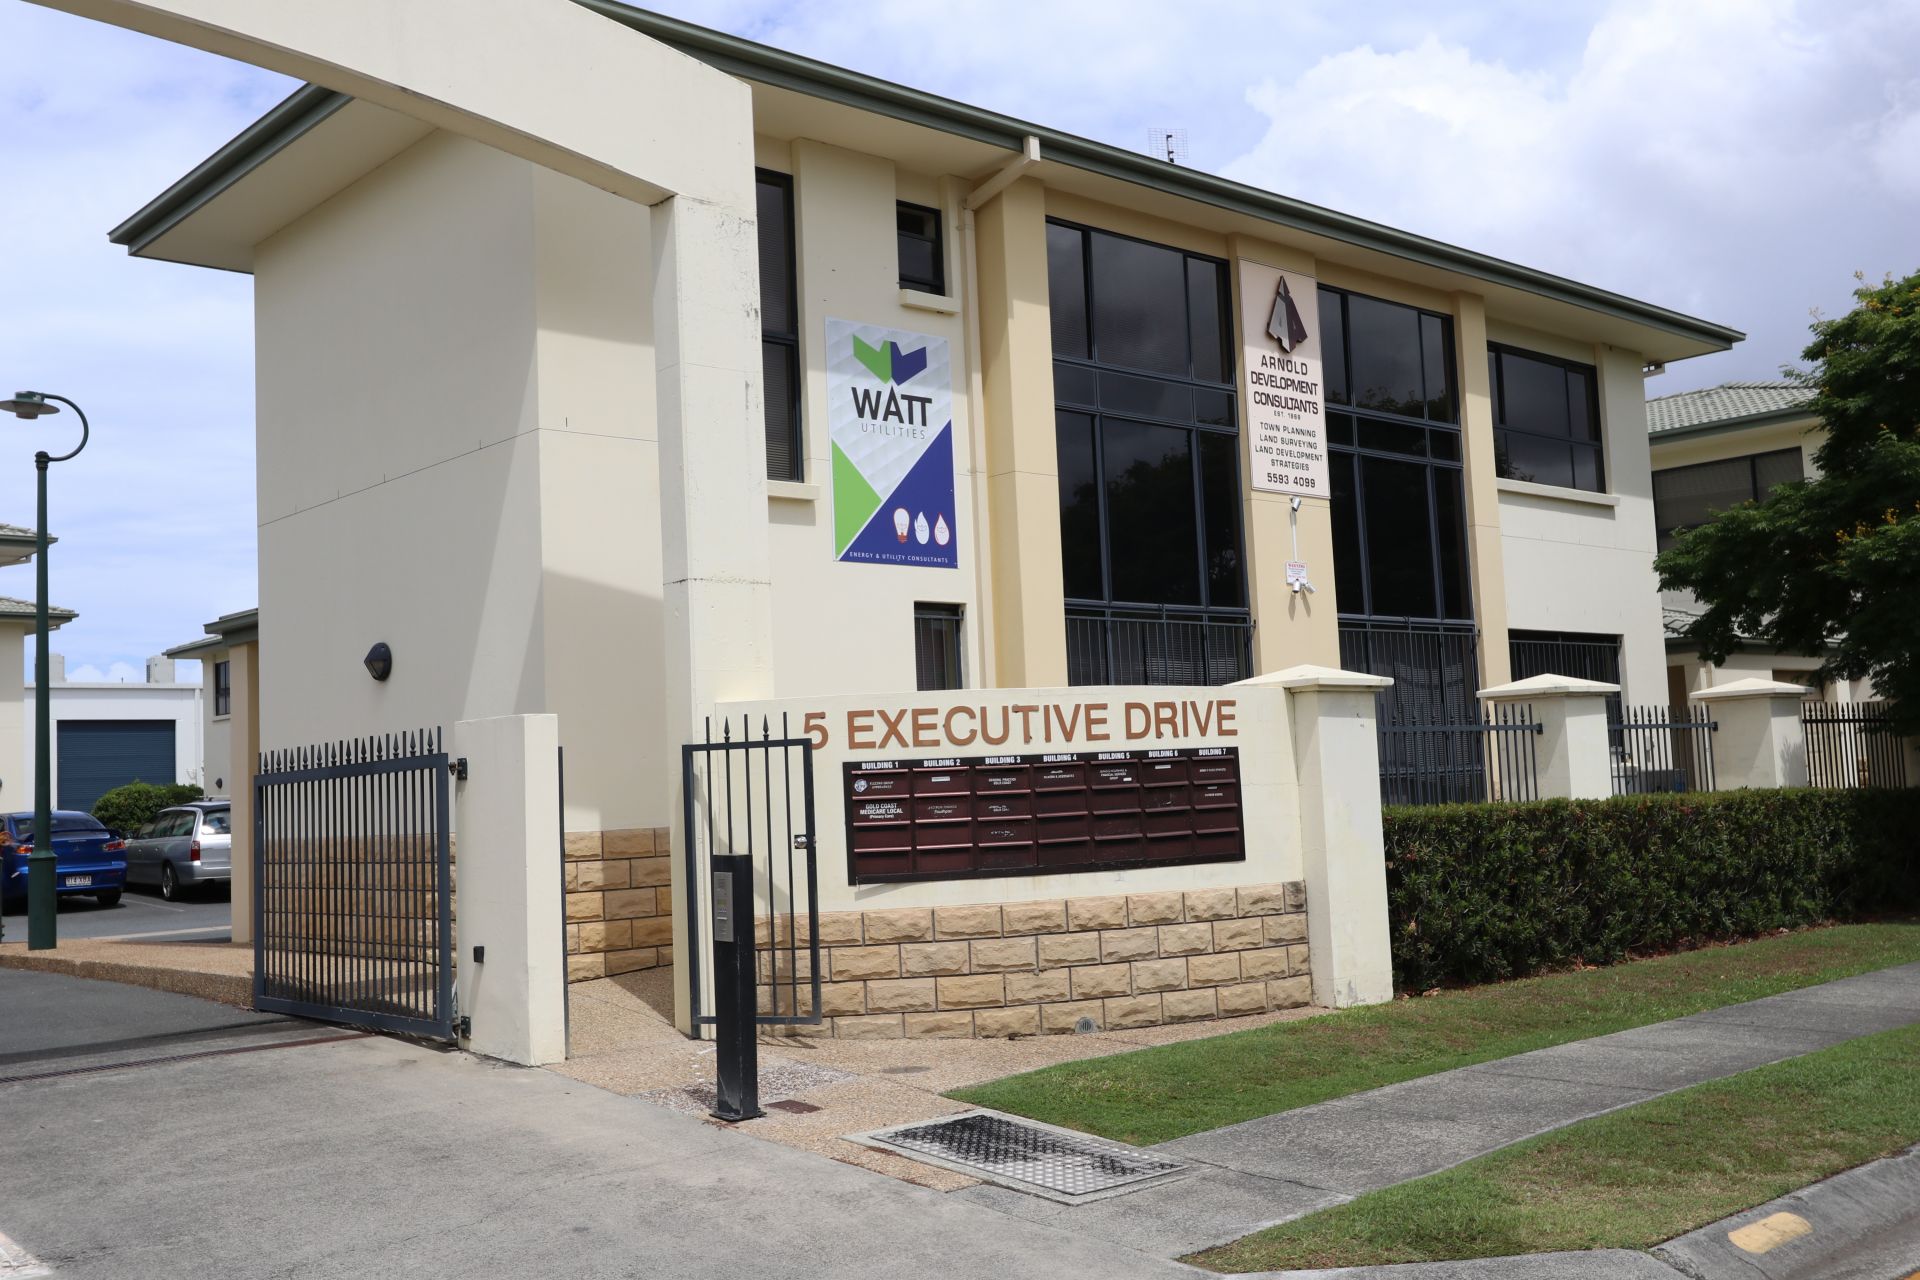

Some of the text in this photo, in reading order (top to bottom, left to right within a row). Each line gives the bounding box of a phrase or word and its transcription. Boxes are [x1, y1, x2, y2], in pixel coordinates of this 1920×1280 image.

[1261, 354, 1308, 376] ARNOLD
[1251, 371, 1318, 396] DEVELOPMENT
[851, 385, 932, 427] WATT
[1253, 391, 1319, 415] CONSULTANTS
[861, 423, 926, 440] UTILITIES
[1260, 422, 1316, 438] TOWN PLANNING
[1260, 433, 1318, 450] LAND SURVEYING
[1255, 445, 1323, 462] LAND DEVELOPMENT
[1270, 458, 1310, 471] STRATEGIES
[1267, 472, 1316, 488] 5593 4099
[907, 555, 948, 563] CONSULTANTS
[803, 699, 1238, 751] 5 EXECUTIVE DRIVE
[985, 756, 1015, 764] BUILDING
[1043, 753, 1077, 762] BUILDING 4
[1098, 752, 1125, 760] BUILDING
[1148, 749, 1178, 758] BUILDING 6
[1198, 748, 1222, 756] BUILDING
[861, 761, 893, 769] BUILDING
[924, 759, 955, 767] BUILDING
